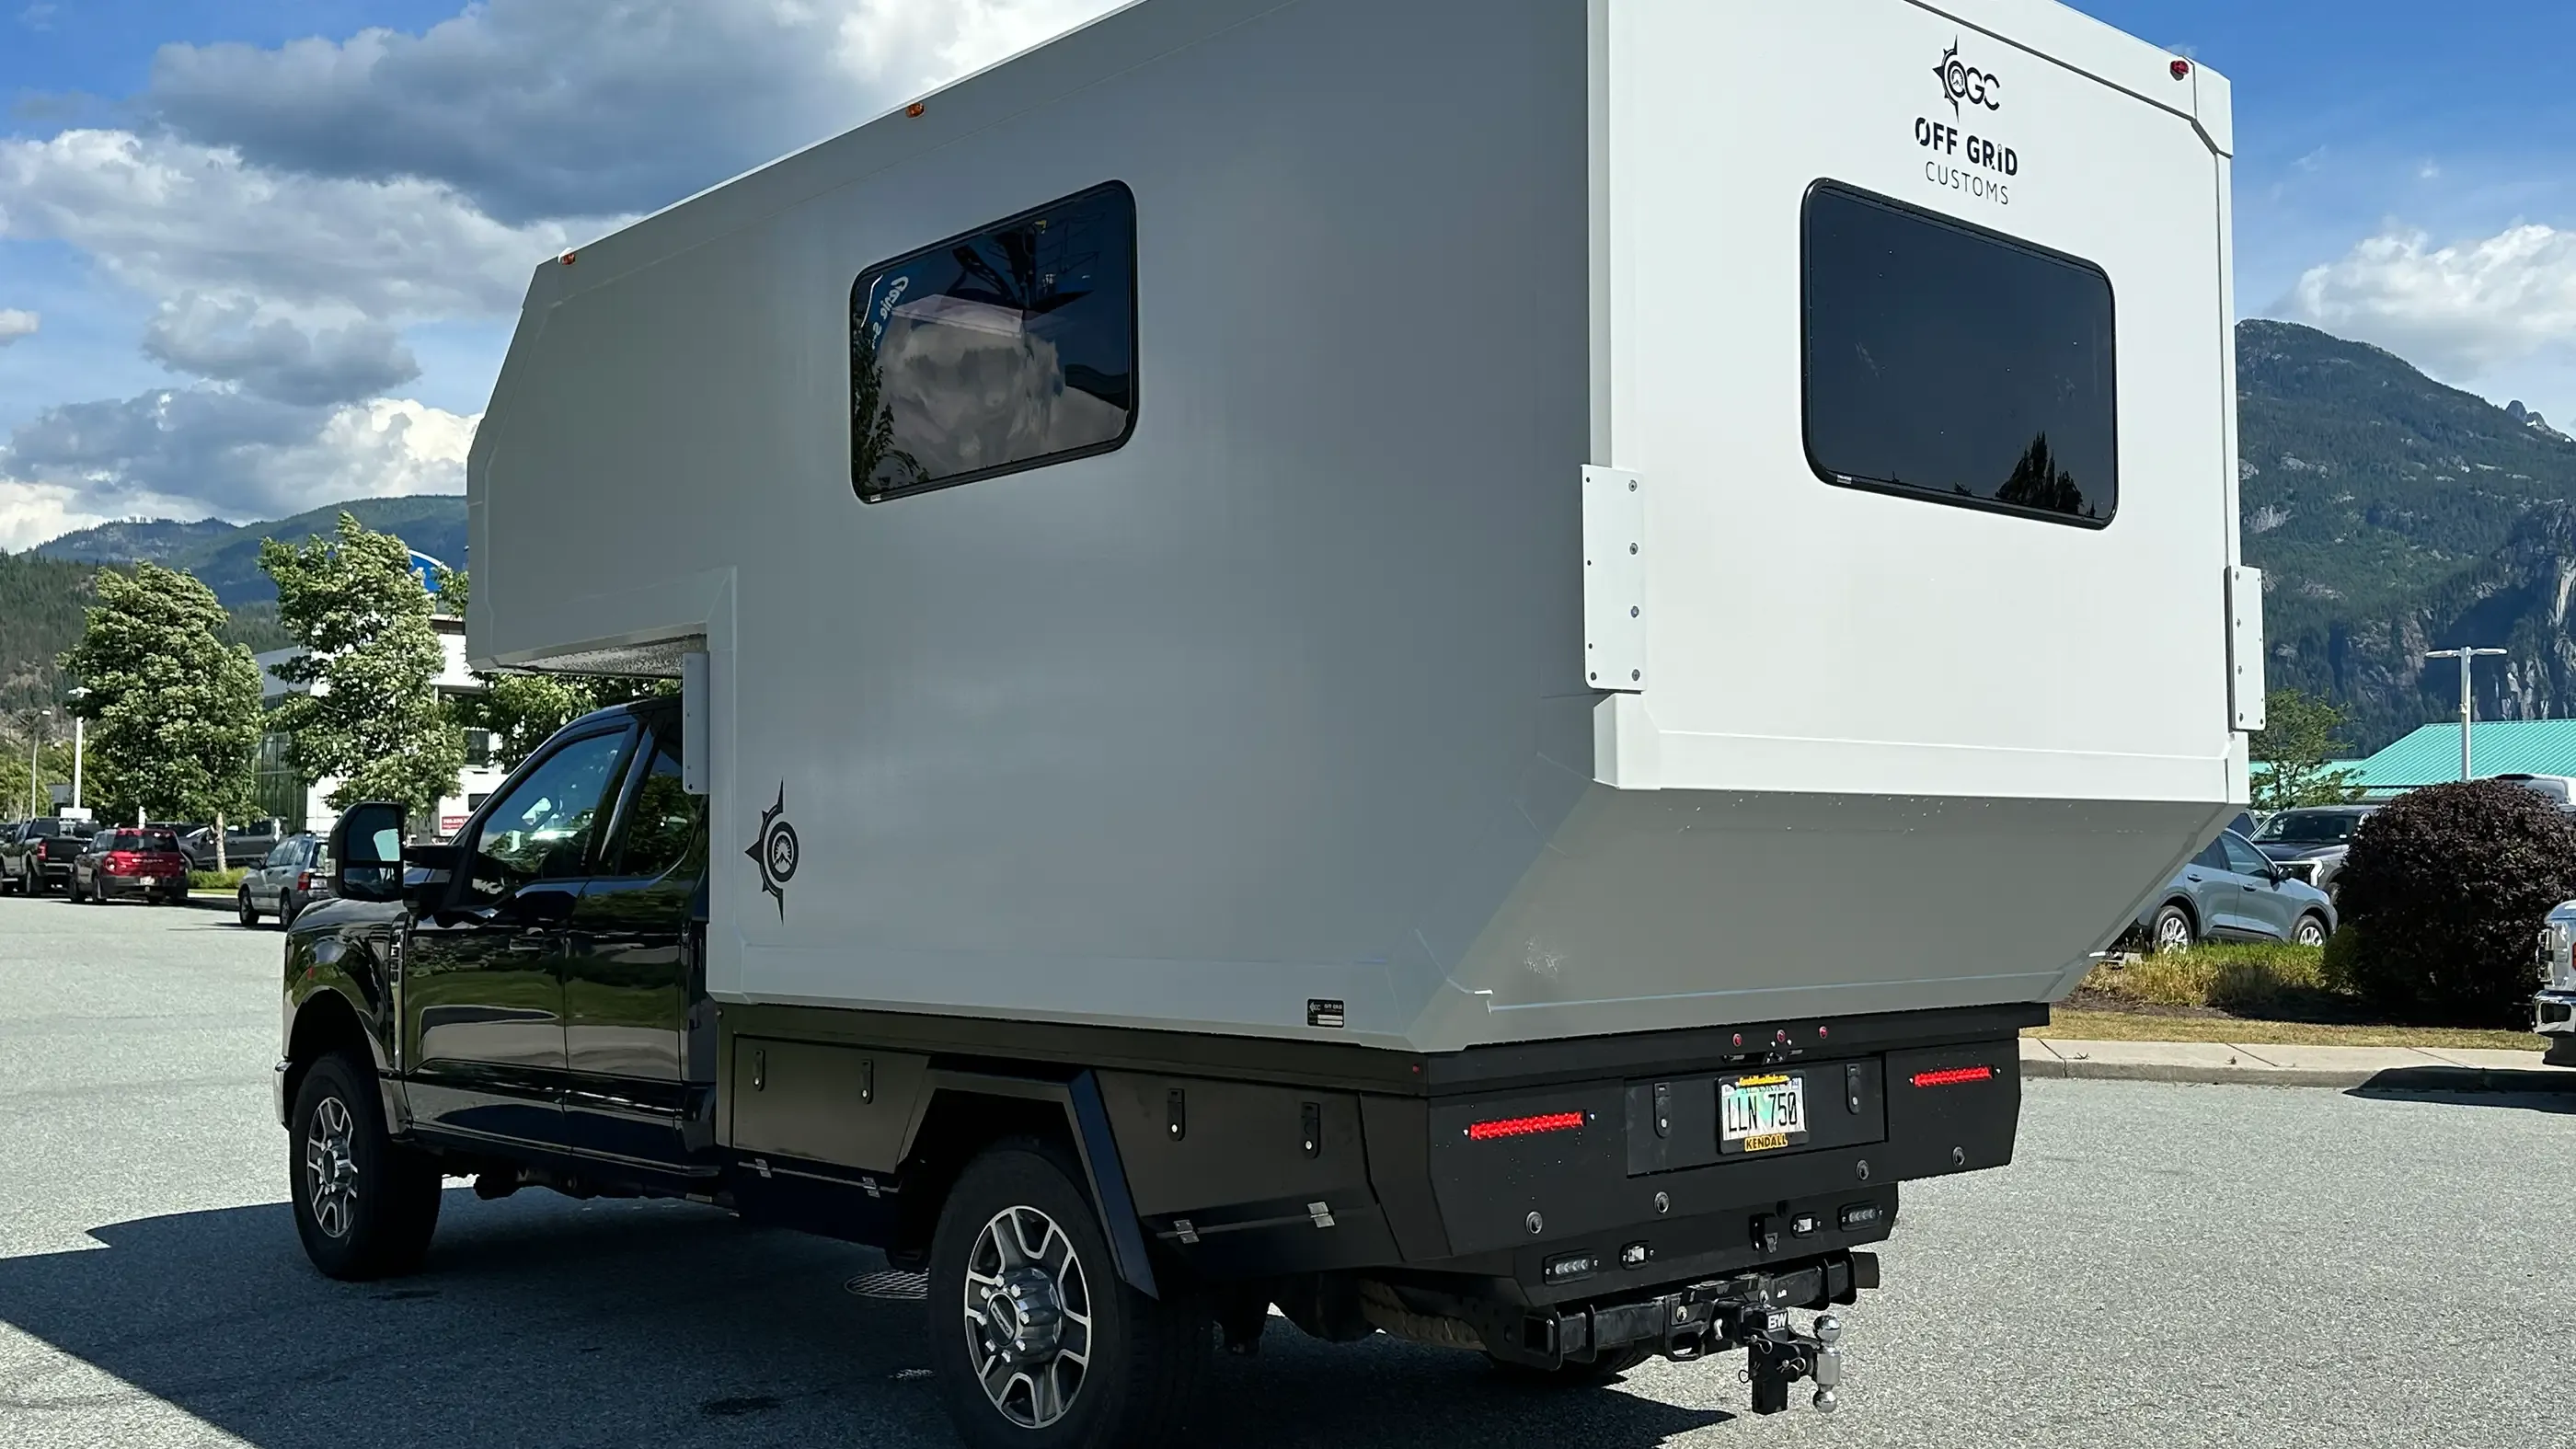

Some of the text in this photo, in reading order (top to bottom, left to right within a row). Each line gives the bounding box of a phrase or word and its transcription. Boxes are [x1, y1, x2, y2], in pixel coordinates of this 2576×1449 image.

[1915, 117, 1959, 155] OFF
[1926, 161, 2008, 205] CUSTOMS
[1728, 1091, 1798, 1133] LLN 750
[1745, 1133, 1787, 1149] KENDALL
